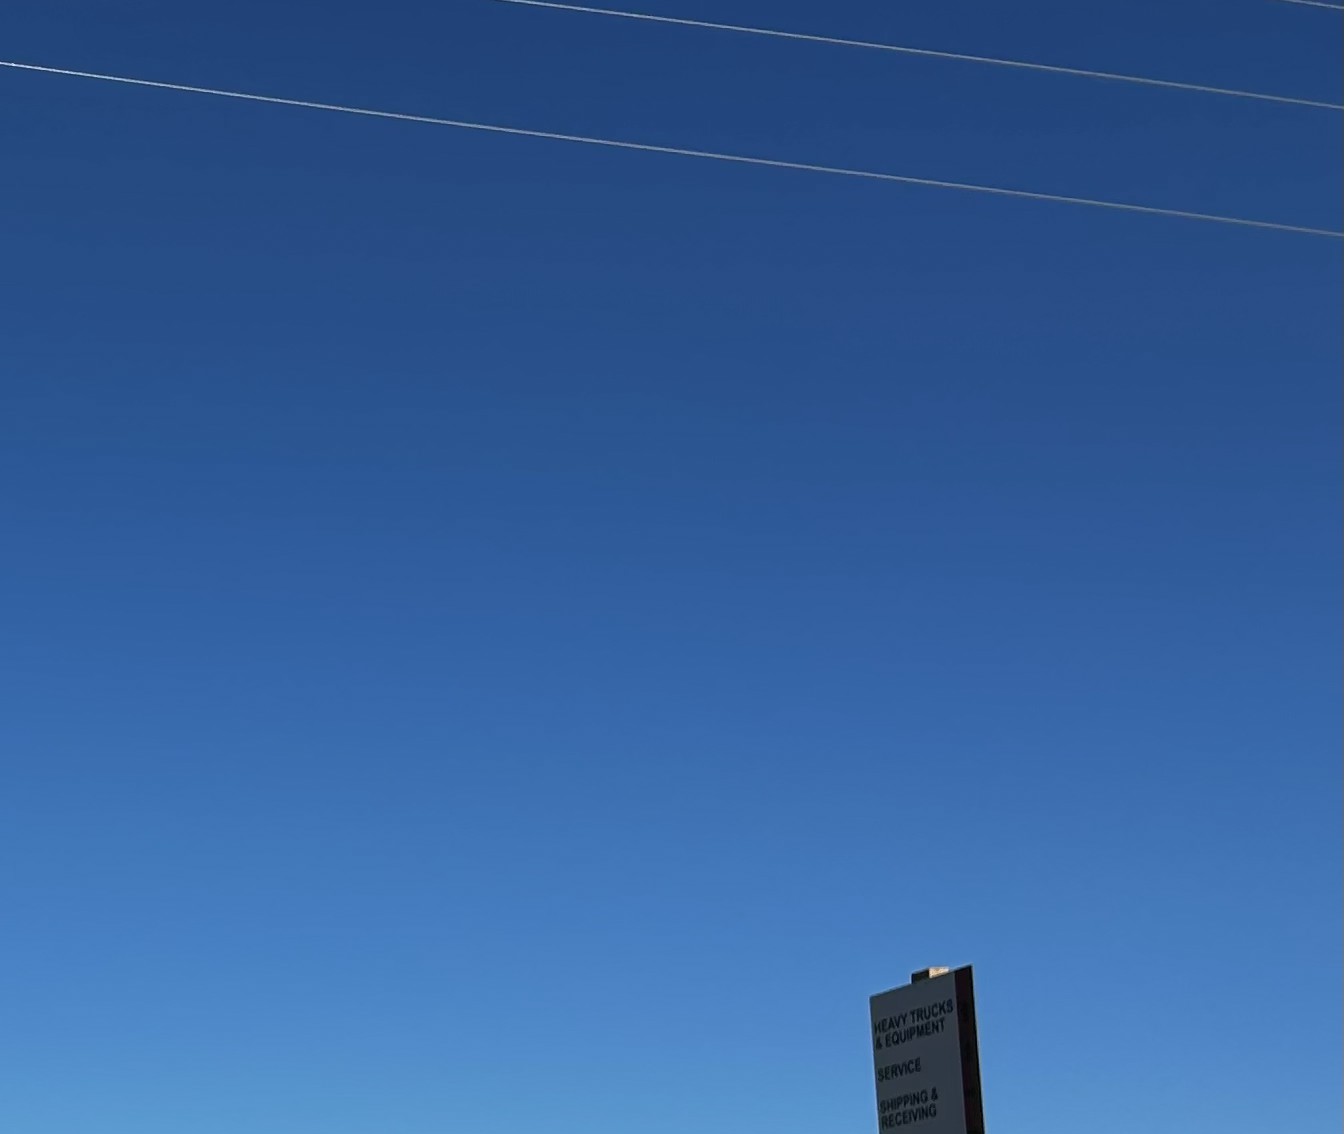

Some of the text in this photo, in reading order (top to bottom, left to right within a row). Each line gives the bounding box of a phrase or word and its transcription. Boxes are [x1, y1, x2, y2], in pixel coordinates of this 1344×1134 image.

[874, 998, 954, 1035] HEAVY TRUCKS
[875, 1018, 946, 1050] & EQUIPMENT
[877, 1057, 922, 1082] SERVICE
[879, 1087, 939, 1115] SHIPPING &
[881, 1103, 937, 1130] RECEIVING
